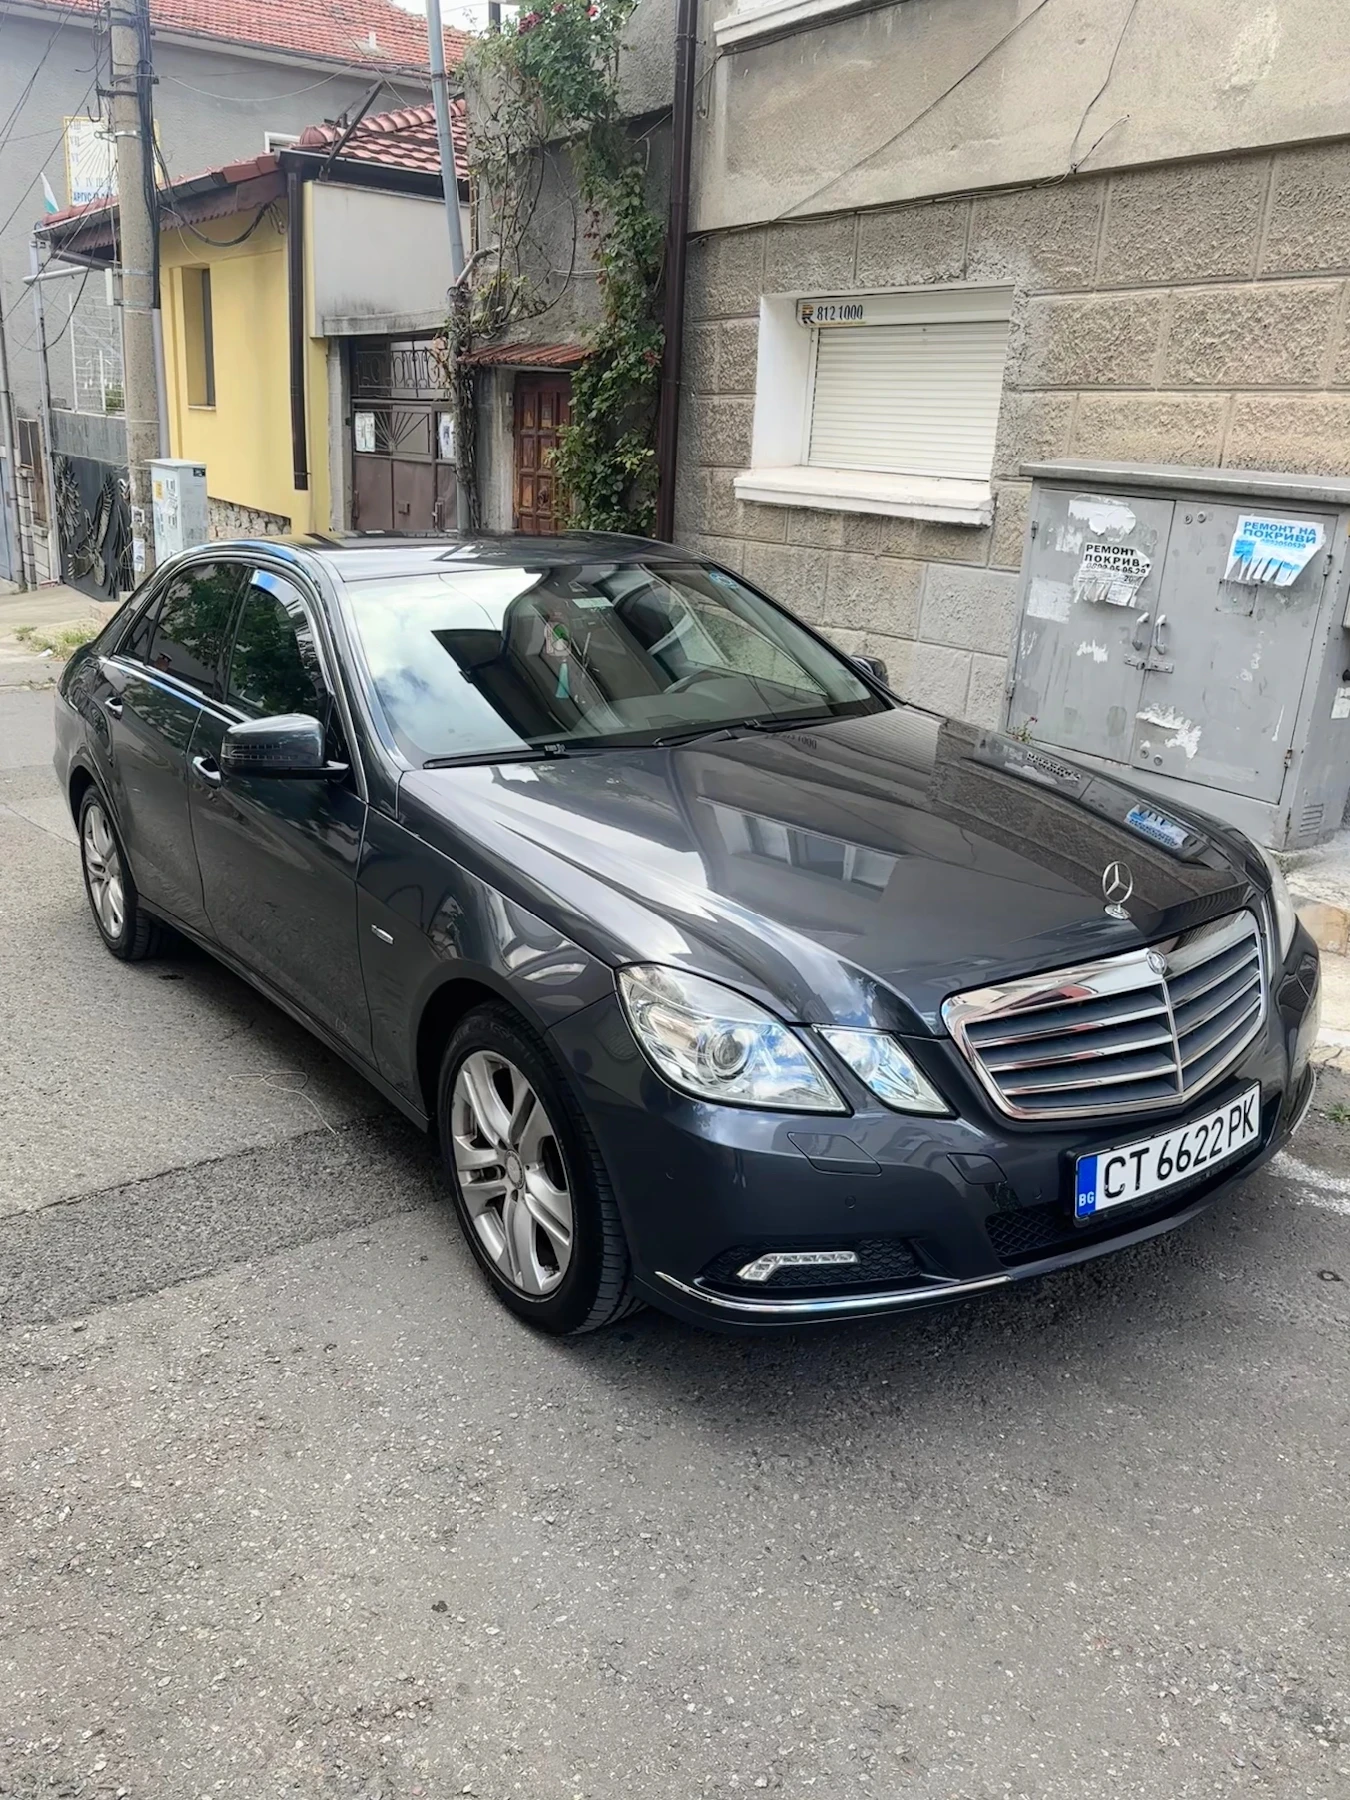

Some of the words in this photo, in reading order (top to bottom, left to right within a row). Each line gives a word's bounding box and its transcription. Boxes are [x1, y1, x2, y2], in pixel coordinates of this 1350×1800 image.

[1243, 529, 1317, 544] ПОКРИВИ
[1244, 521, 1296, 534] РЕМОНТ
[1298, 527, 1317, 537] НА
[1086, 544, 1135, 556] РЕМОНТ
[1104, 1147, 1150, 1199] CT
[1157, 1116, 1224, 1181] 6622
[1227, 1093, 1255, 1148] PK
[1078, 1190, 1095, 1207] BG
